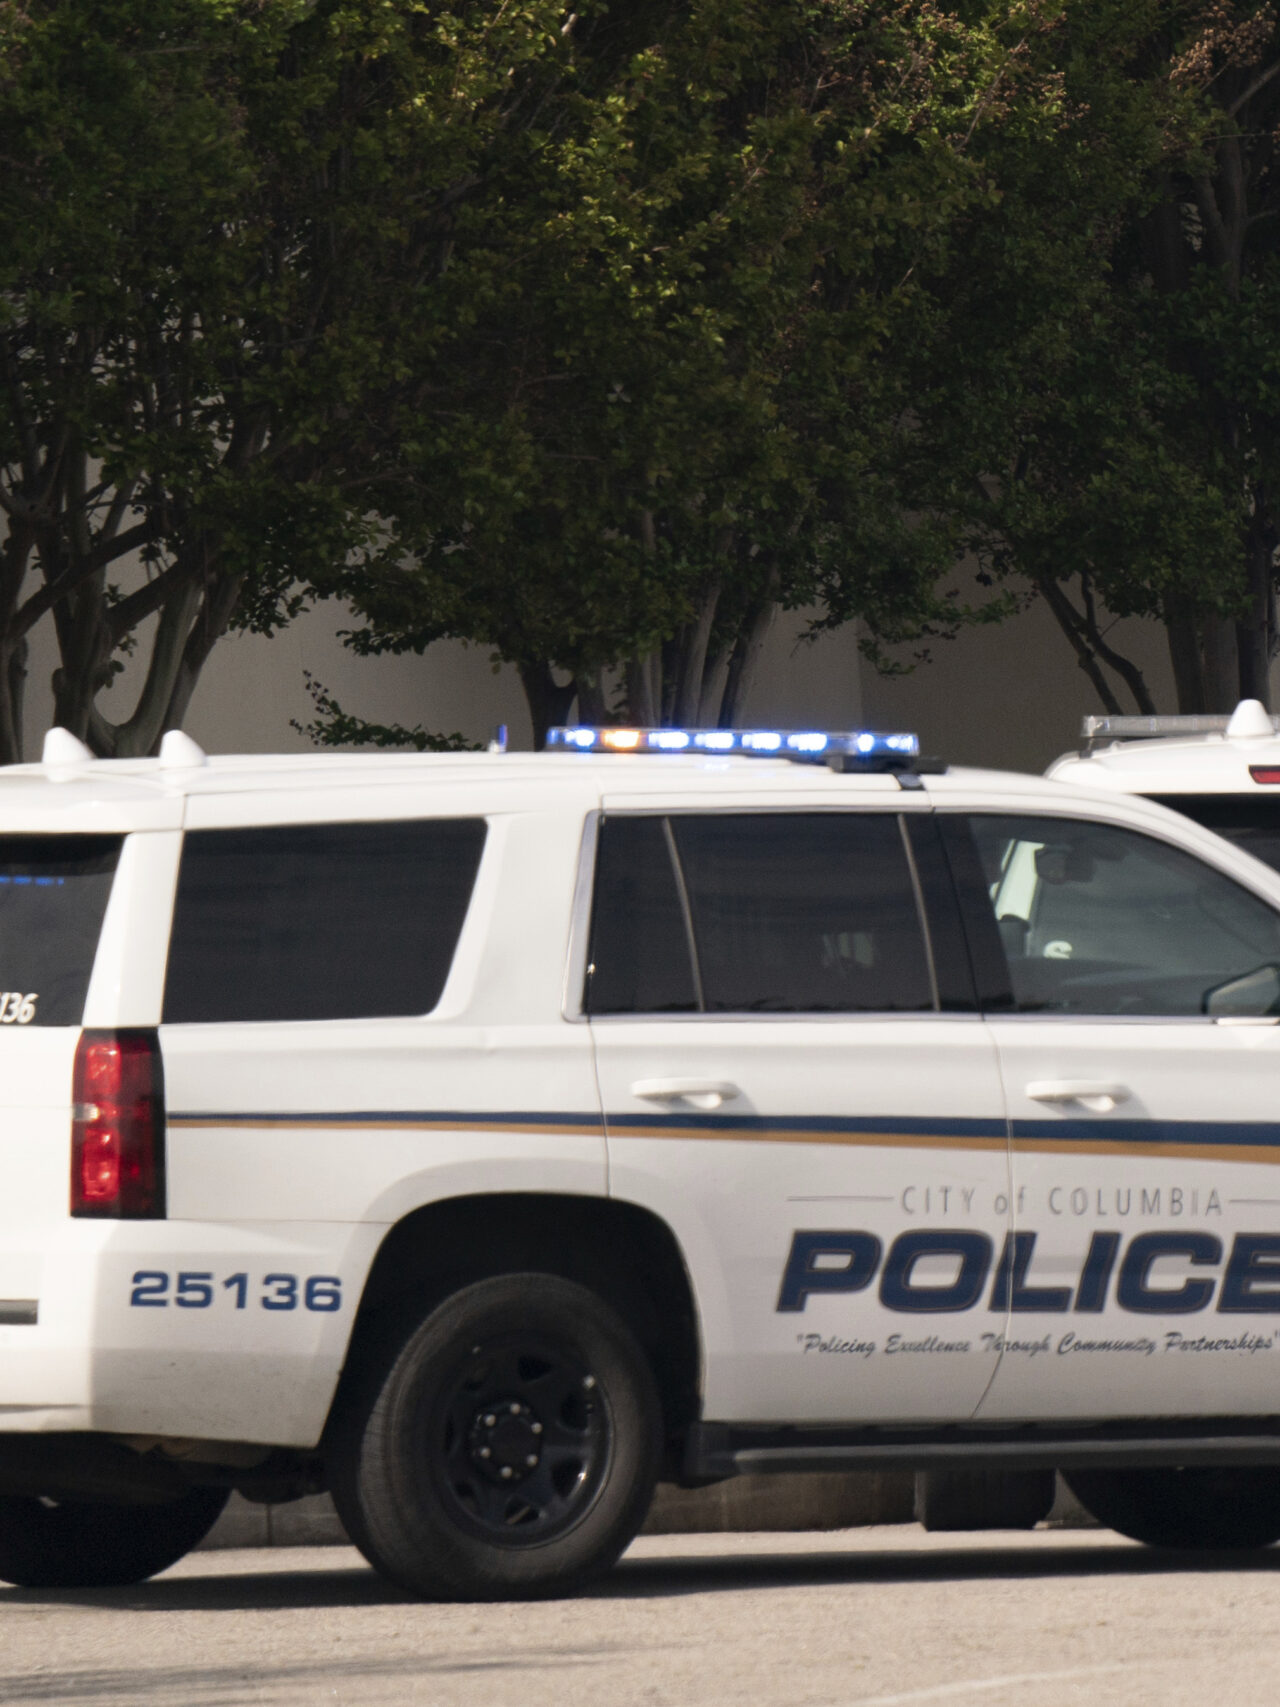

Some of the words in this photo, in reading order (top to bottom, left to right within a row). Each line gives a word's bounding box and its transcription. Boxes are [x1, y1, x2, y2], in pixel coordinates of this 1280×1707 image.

[901, 1186, 975, 1215] CITY
[994, 1186, 1027, 1216] of
[1049, 1186, 1223, 1217] COLUMBIA
[130, 1270, 343, 1313] 25136
[884, 1334, 971, 1355] Excellence
[980, 1332, 1052, 1358] Through
[1056, 1332, 1158, 1357] Community
